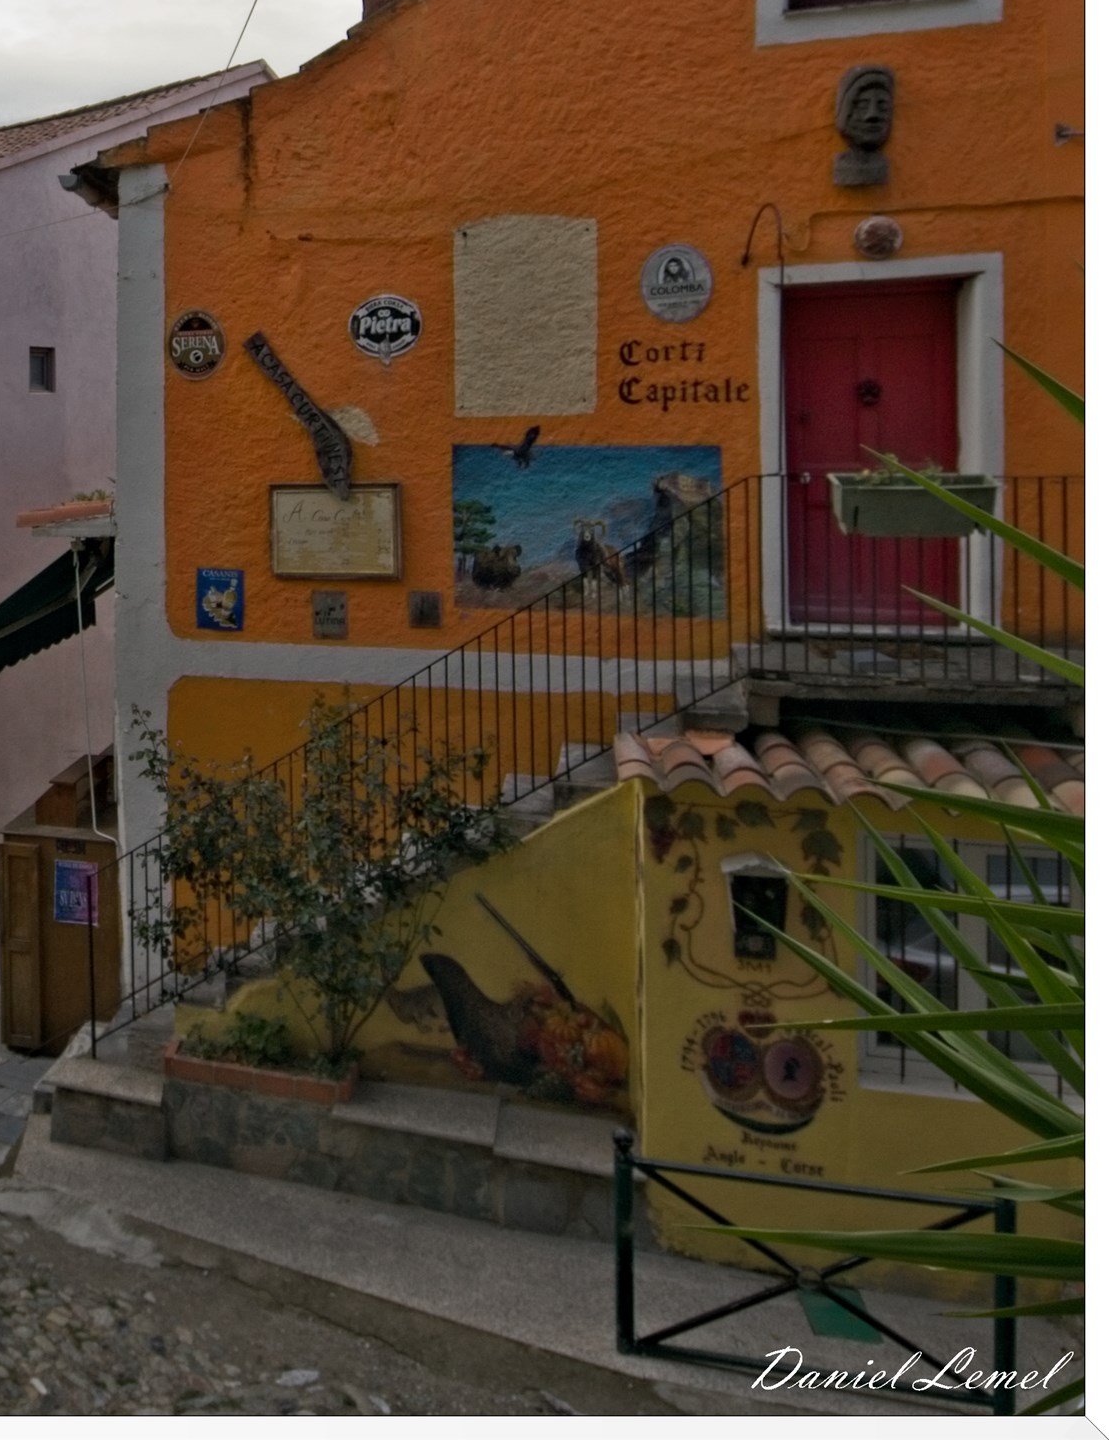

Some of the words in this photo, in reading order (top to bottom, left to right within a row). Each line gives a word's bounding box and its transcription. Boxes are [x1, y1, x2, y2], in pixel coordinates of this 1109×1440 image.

[650, 282, 705, 296] COLOMBA
[359, 316, 412, 335] Pietra
[171, 335, 221, 357] SERENA
[619, 339, 706, 366] Corti
[618, 376, 750, 412] Capitale
[202, 569, 238, 578] CASANIS
